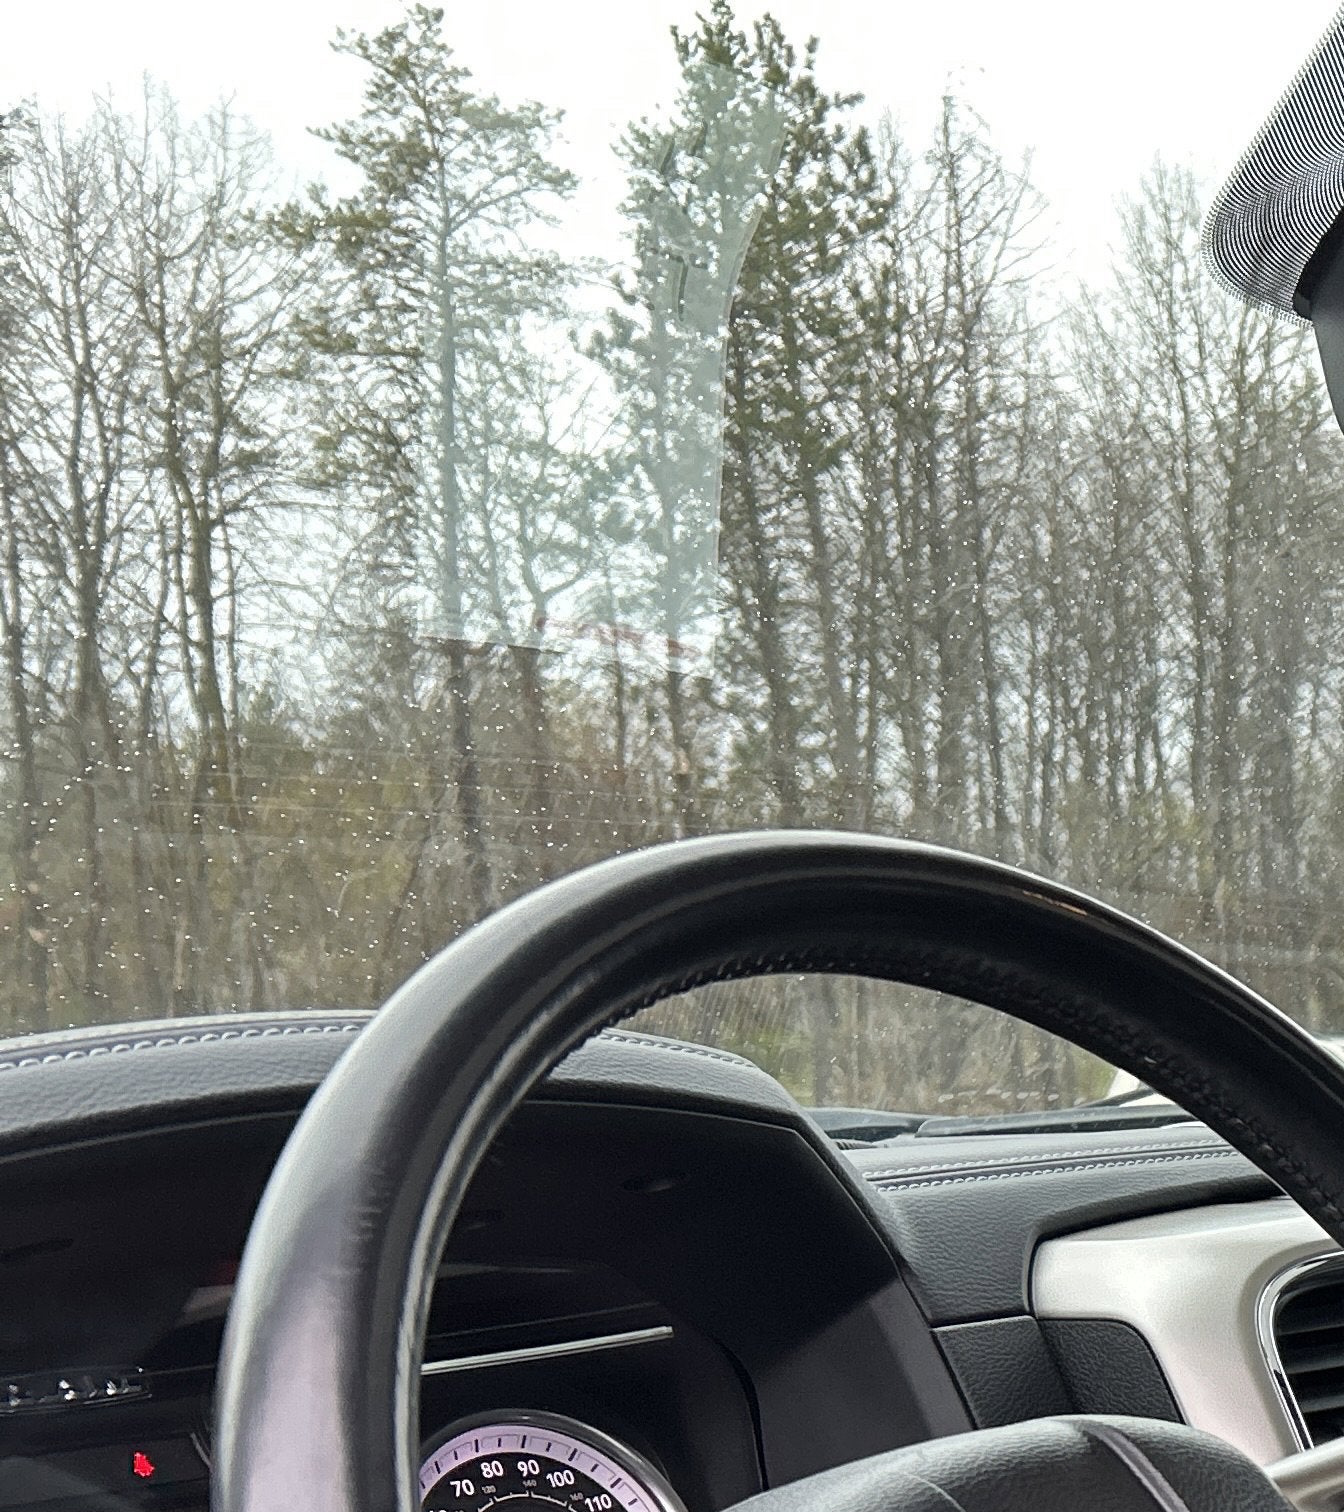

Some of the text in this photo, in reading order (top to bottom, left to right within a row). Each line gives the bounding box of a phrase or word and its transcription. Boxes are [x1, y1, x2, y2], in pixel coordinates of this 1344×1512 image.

[480, 1460, 504, 1479] 80
[517, 1459, 540, 1477] 90
[450, 1479, 475, 1498] 70
[546, 1470, 575, 1488] 100
[585, 1493, 613, 1512] 110
